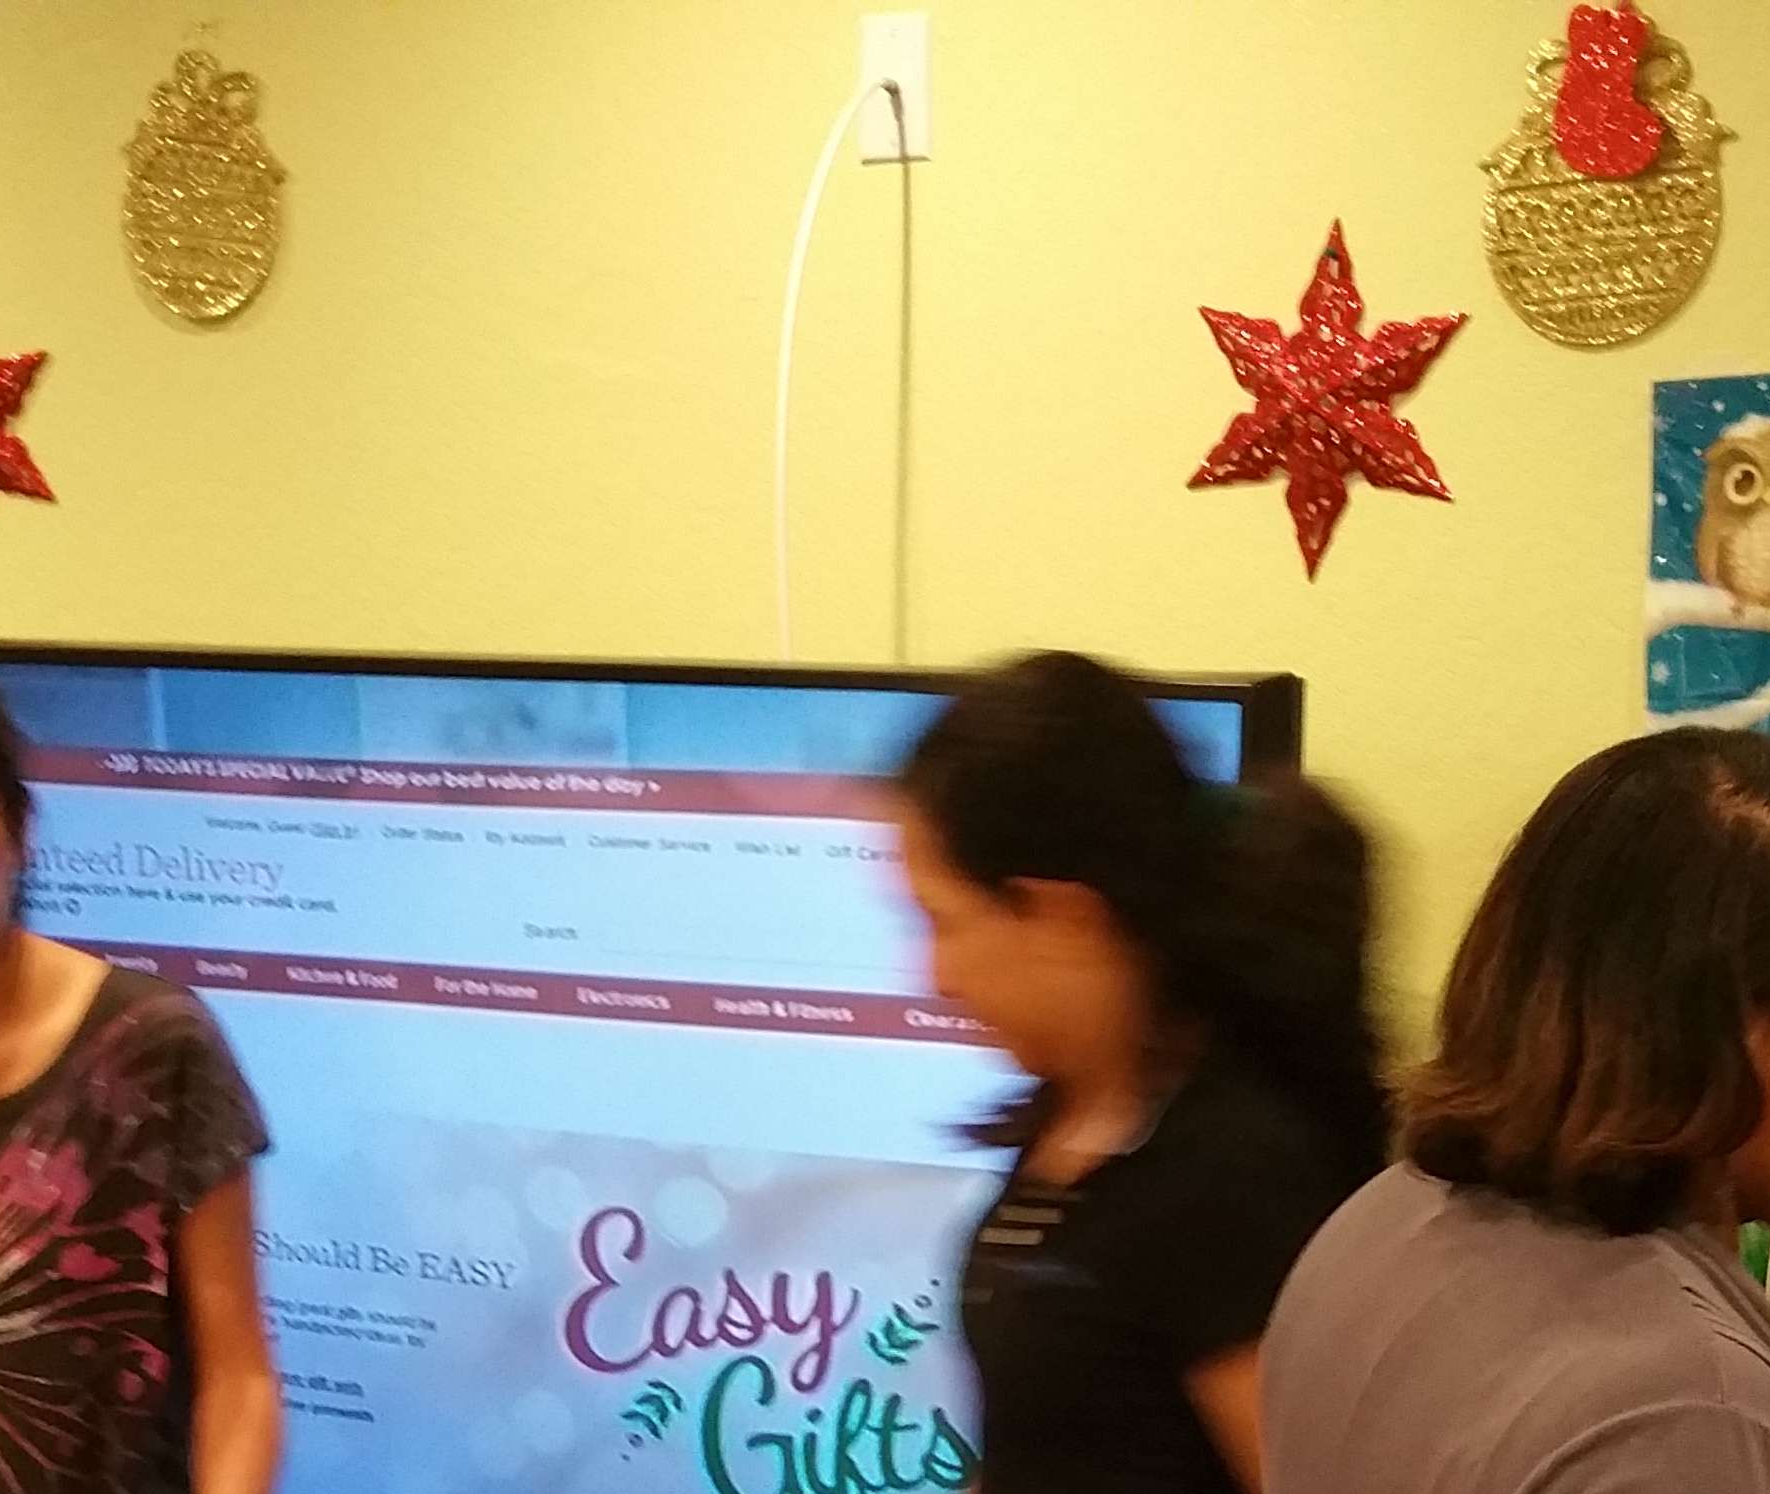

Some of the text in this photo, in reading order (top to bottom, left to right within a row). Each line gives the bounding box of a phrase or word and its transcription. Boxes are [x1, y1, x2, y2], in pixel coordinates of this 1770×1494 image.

[360, 766, 407, 788] Shop
[133, 842, 284, 893] Delivery
[576, 985, 671, 1011] Electronics
[712, 997, 770, 1017] Health
[789, 1001, 855, 1023] Fitness
[253, 1228, 518, 1291] Should Be EASY
[565, 1206, 861, 1393] Easy
